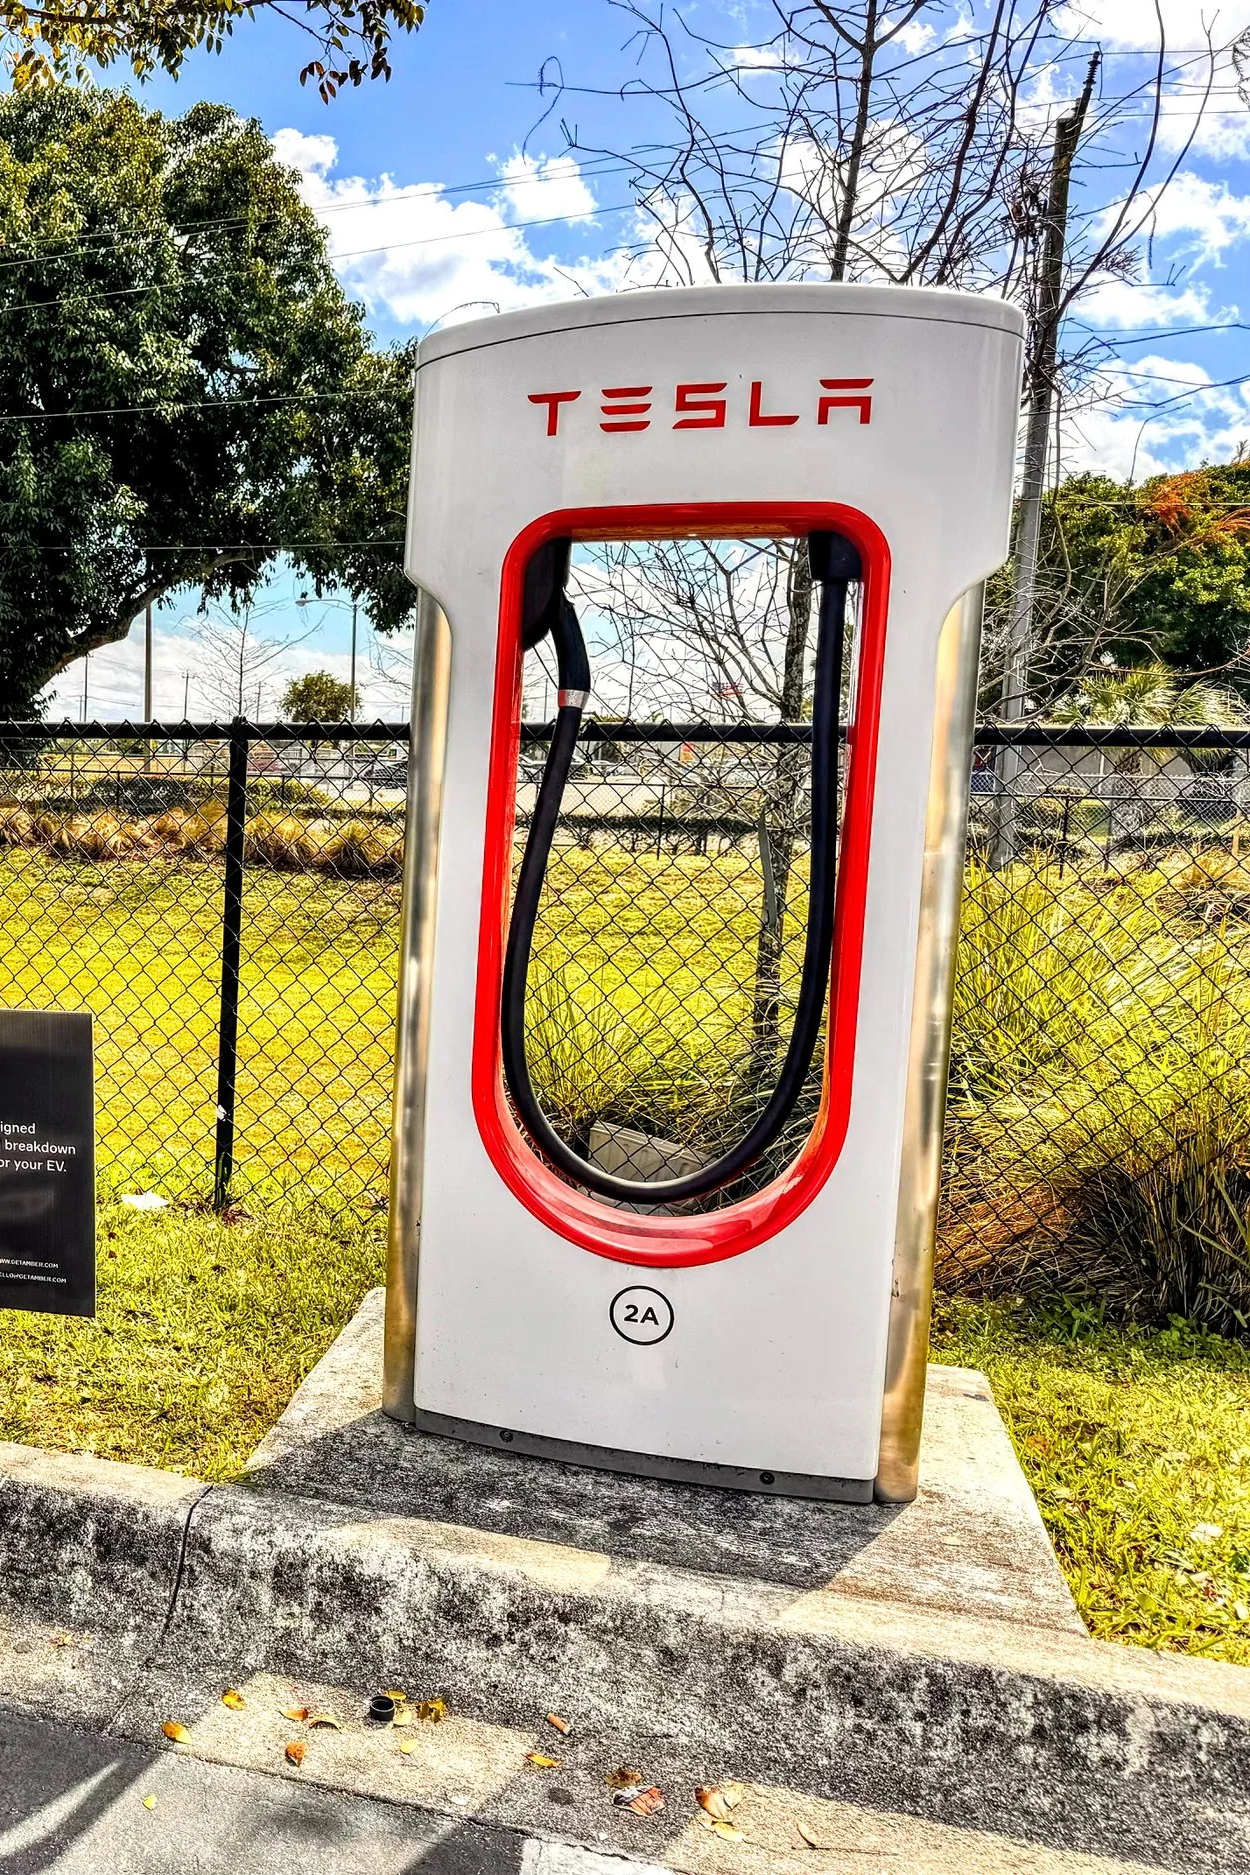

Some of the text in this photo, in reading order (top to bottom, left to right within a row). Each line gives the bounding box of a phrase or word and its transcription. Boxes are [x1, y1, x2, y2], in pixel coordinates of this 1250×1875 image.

[527, 378, 875, 437] TESLA
[4, 1139, 76, 1155] breakdown
[13, 1160, 44, 1171] your
[46, 1160, 67, 1172] EV.
[623, 1304, 660, 1326] 2A
